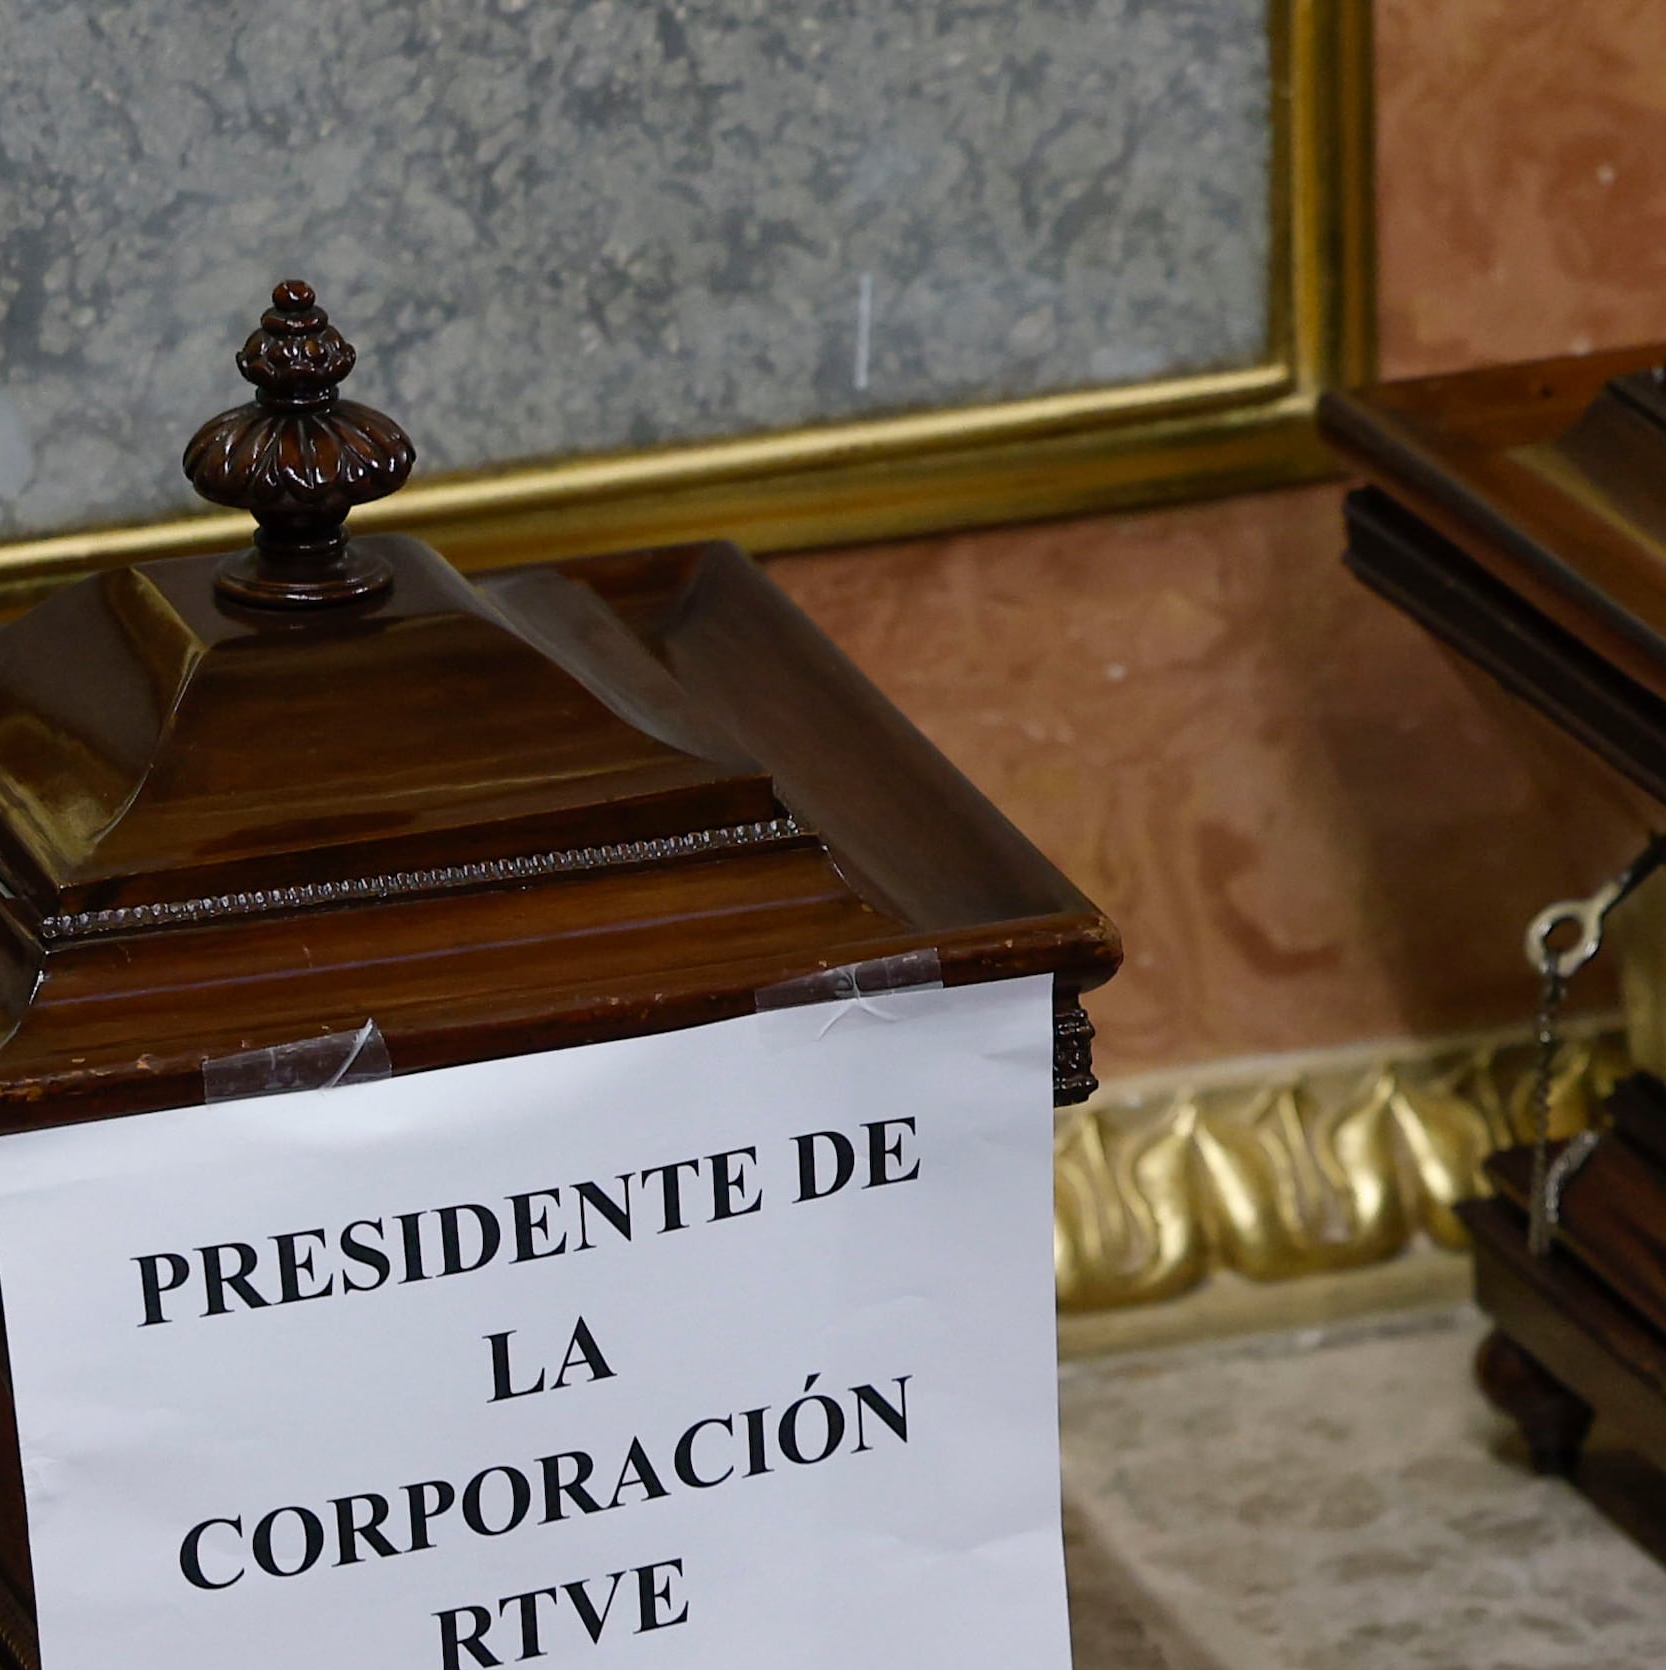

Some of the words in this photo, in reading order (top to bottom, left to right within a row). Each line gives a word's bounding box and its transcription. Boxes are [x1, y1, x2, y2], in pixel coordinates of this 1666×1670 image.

[130, 1145, 764, 1327] PRESIDENTE
[789, 1116, 922, 1204] DE
[482, 1315, 619, 1404] LA
[179, 1372, 913, 1591] CORPORACIÓN
